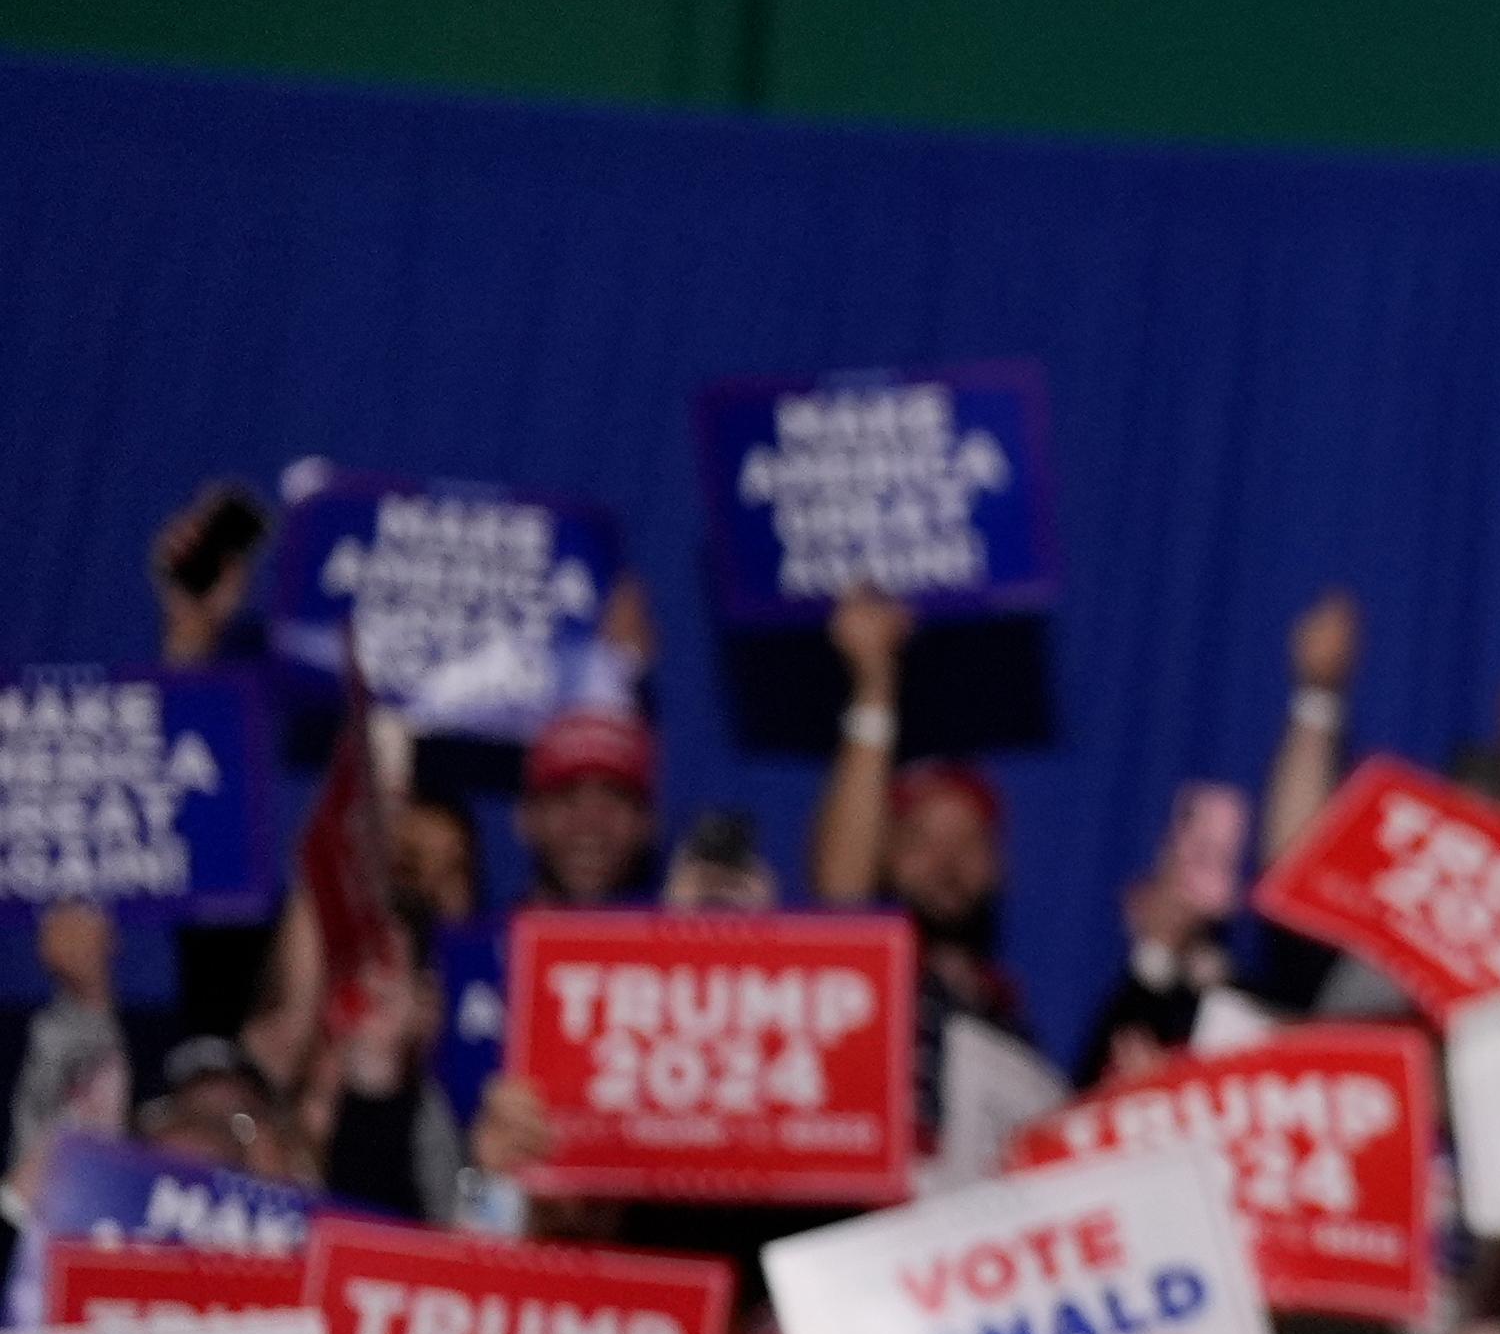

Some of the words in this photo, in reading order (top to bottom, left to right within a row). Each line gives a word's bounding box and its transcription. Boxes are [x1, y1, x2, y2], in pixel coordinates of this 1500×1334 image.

[0, 723, 219, 789] MERICA
[546, 963, 874, 1041] TRUMP
[586, 1031, 827, 1113] 2024
[1232, 1129, 1358, 1213] 24
[145, 1173, 308, 1259] MAK
[898, 1207, 1128, 1317] VOTE
